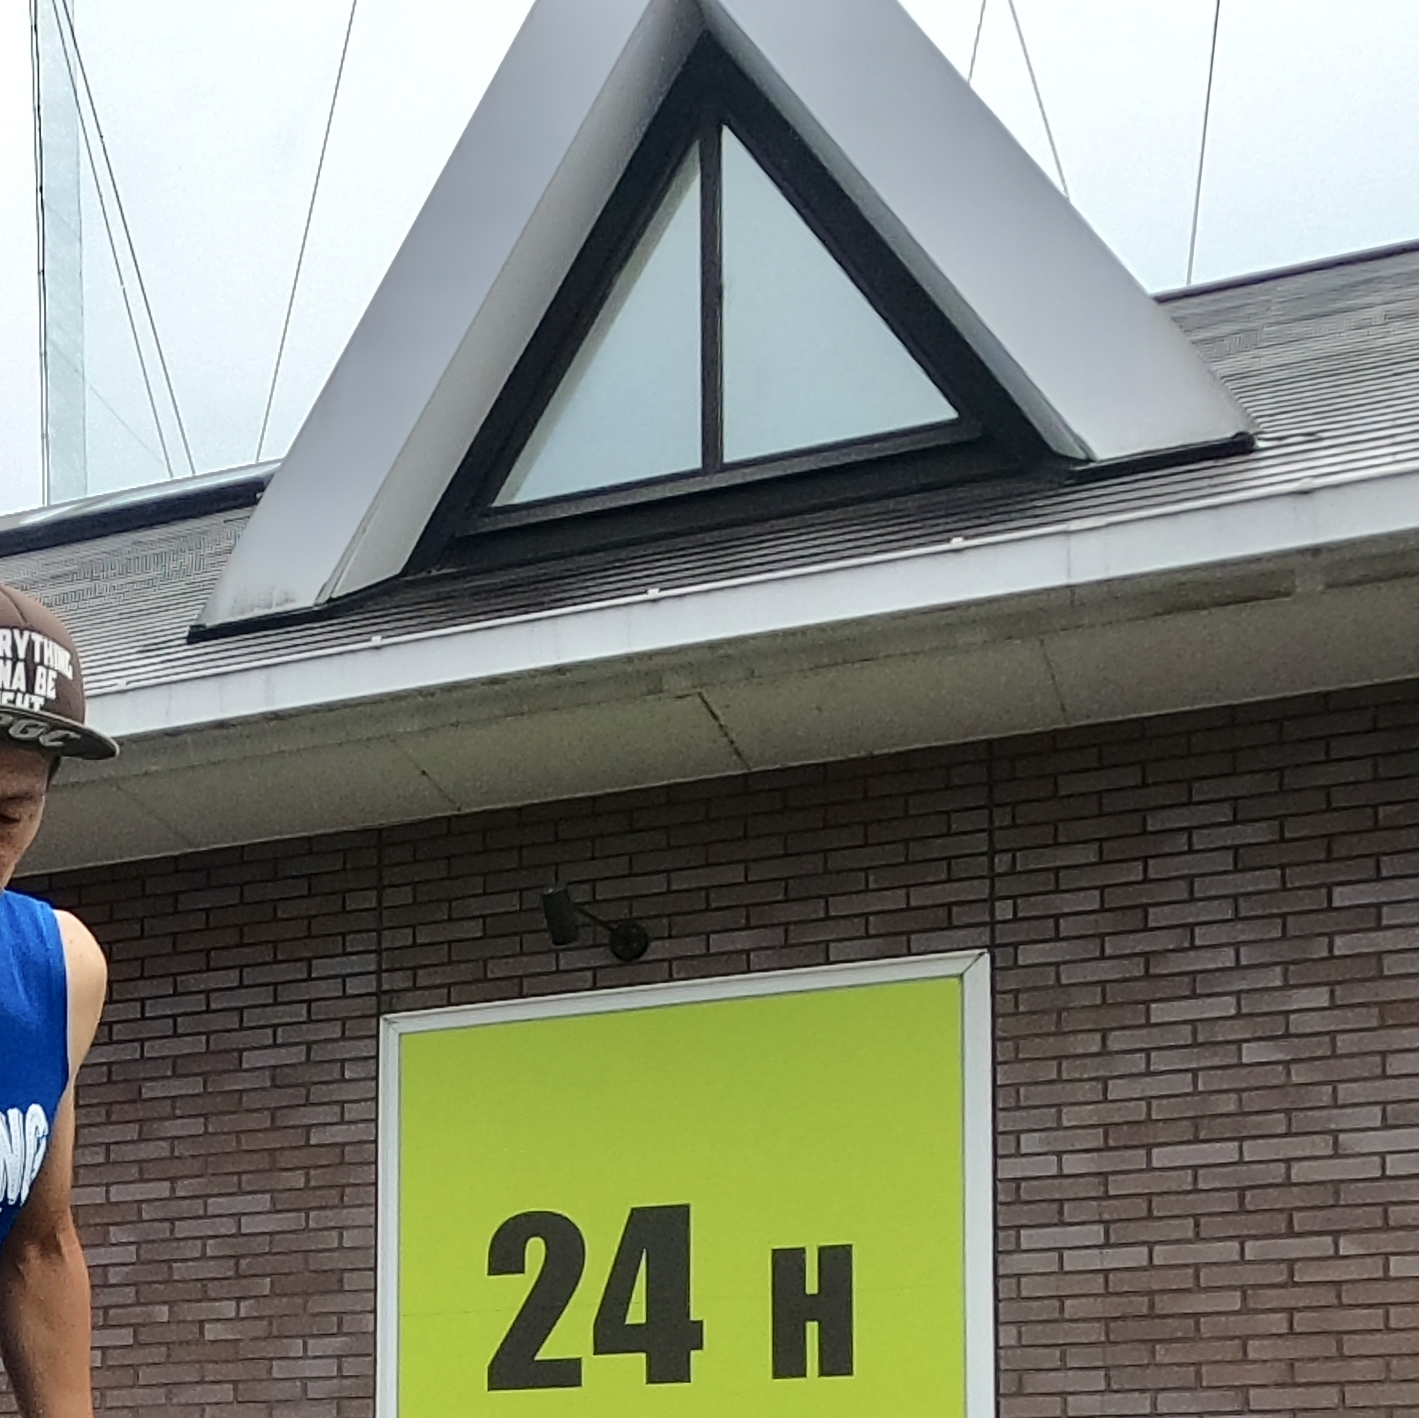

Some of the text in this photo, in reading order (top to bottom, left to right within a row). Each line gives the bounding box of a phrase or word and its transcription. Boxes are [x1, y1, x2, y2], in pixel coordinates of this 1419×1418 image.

[34, 665, 57, 700] BE
[487, 1204, 854, 1391] 24 H
